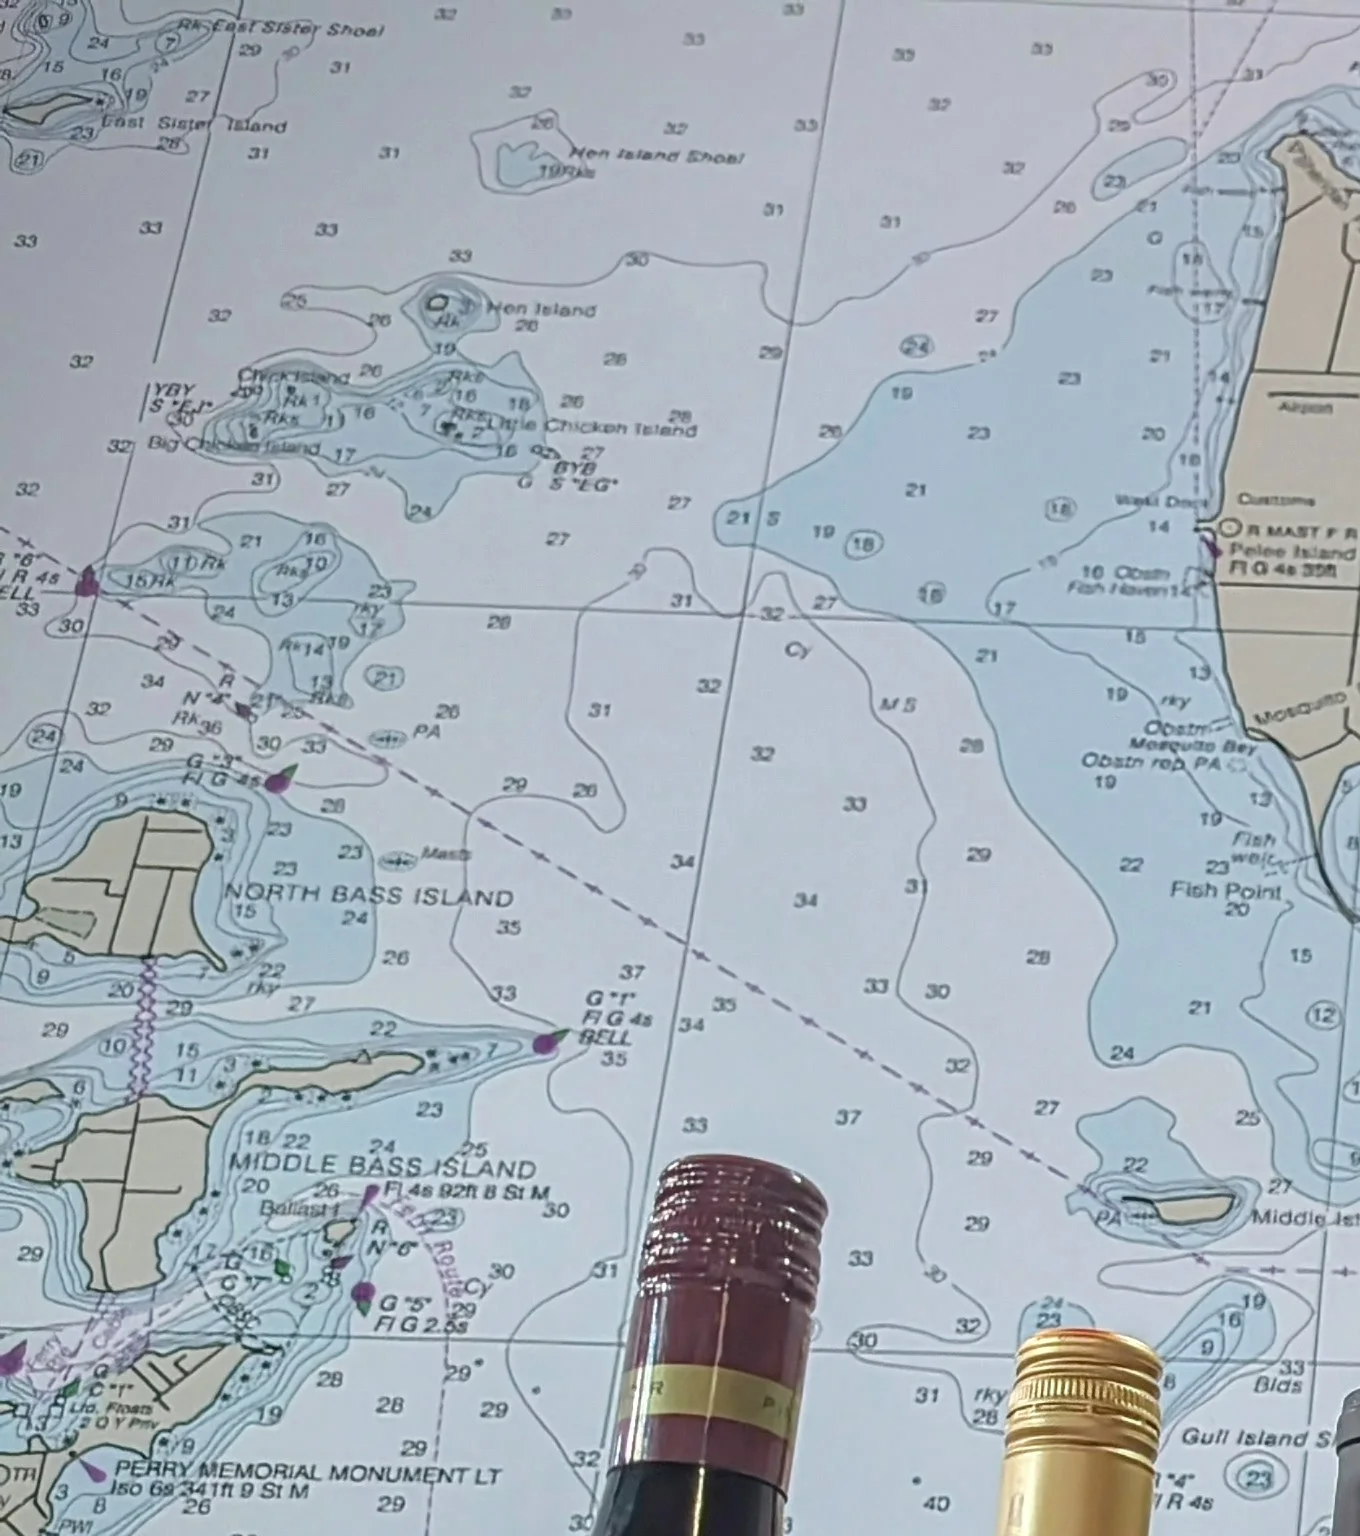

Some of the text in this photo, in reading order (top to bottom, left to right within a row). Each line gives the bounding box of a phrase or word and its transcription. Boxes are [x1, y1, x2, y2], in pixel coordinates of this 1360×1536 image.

[532, 303, 597, 319] Island
[635, 422, 698, 438] Island
[224, 884, 514, 908] NORTH BASS ISLAND
[1170, 881, 1283, 900] Fish Point
[229, 1154, 537, 1180] MIDDLE BASS ISLAND
[1253, 1209, 1326, 1227] Middle
[1182, 1428, 1309, 1448] Gull Island
[115, 1460, 503, 1486] PERRY MEMORIAL MONUMENT LT
[239, 1482, 253, 1498] 9
[259, 1482, 282, 1499] St
[287, 1483, 310, 1499] M
